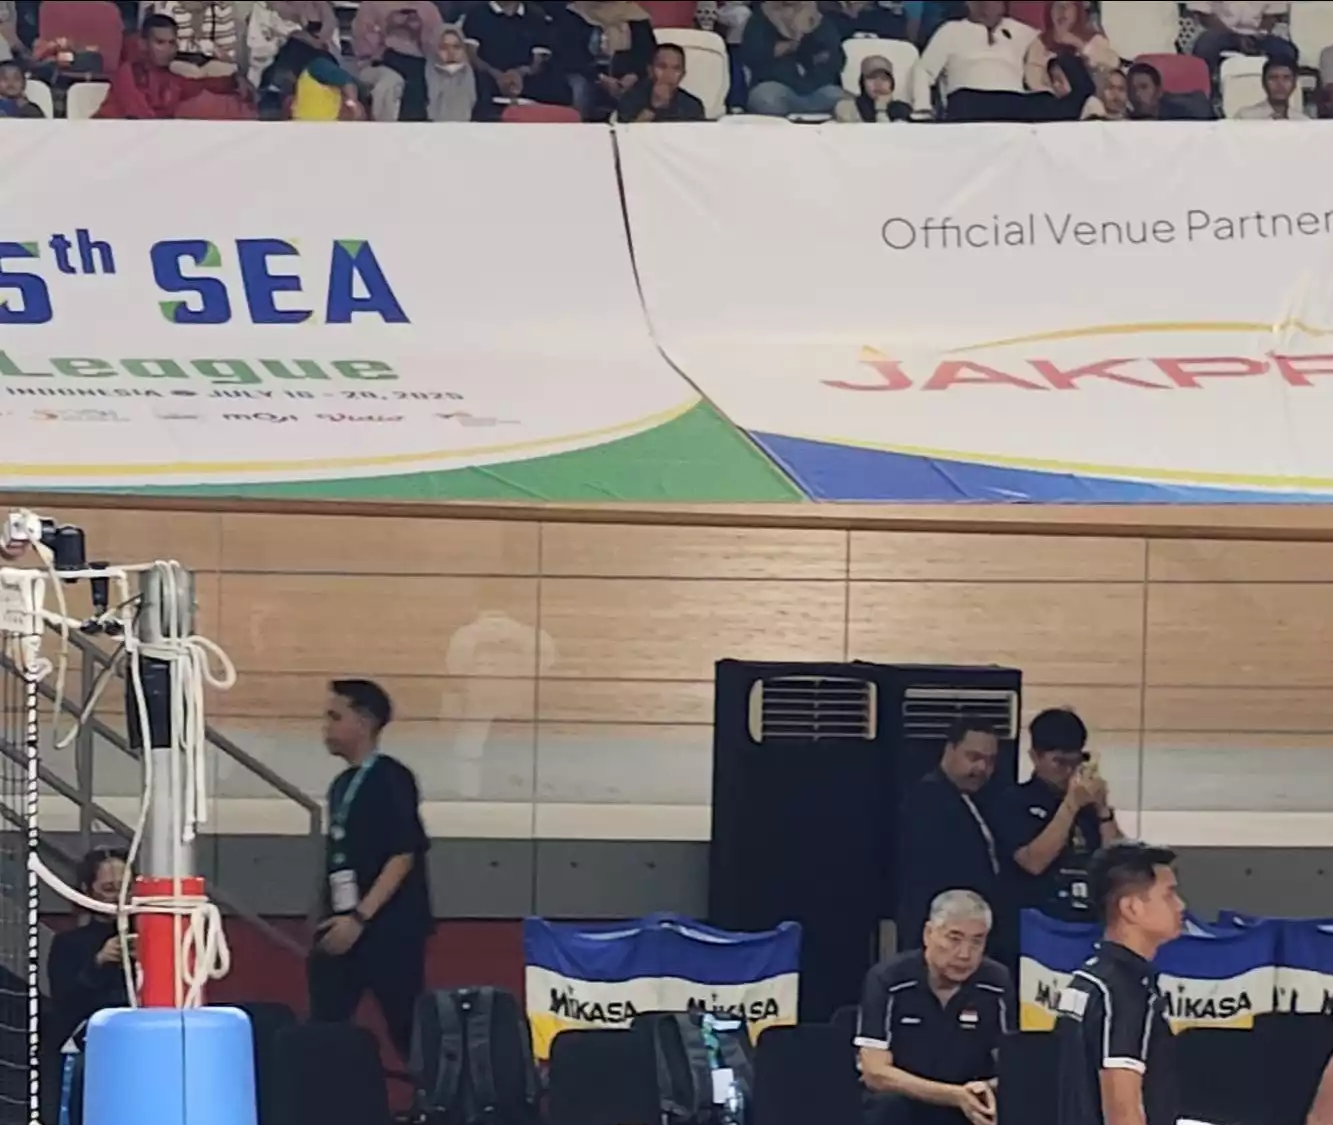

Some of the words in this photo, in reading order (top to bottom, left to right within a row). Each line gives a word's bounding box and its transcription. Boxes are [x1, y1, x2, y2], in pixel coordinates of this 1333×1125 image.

[881, 213, 1036, 250] Official
[1044, 213, 1176, 246] Venue
[150, 238, 412, 325] SEA
[7, 386, 163, 398] INDONESIA
[207, 388, 273, 399] JULY
[549, 985, 637, 1023] MIKASA
